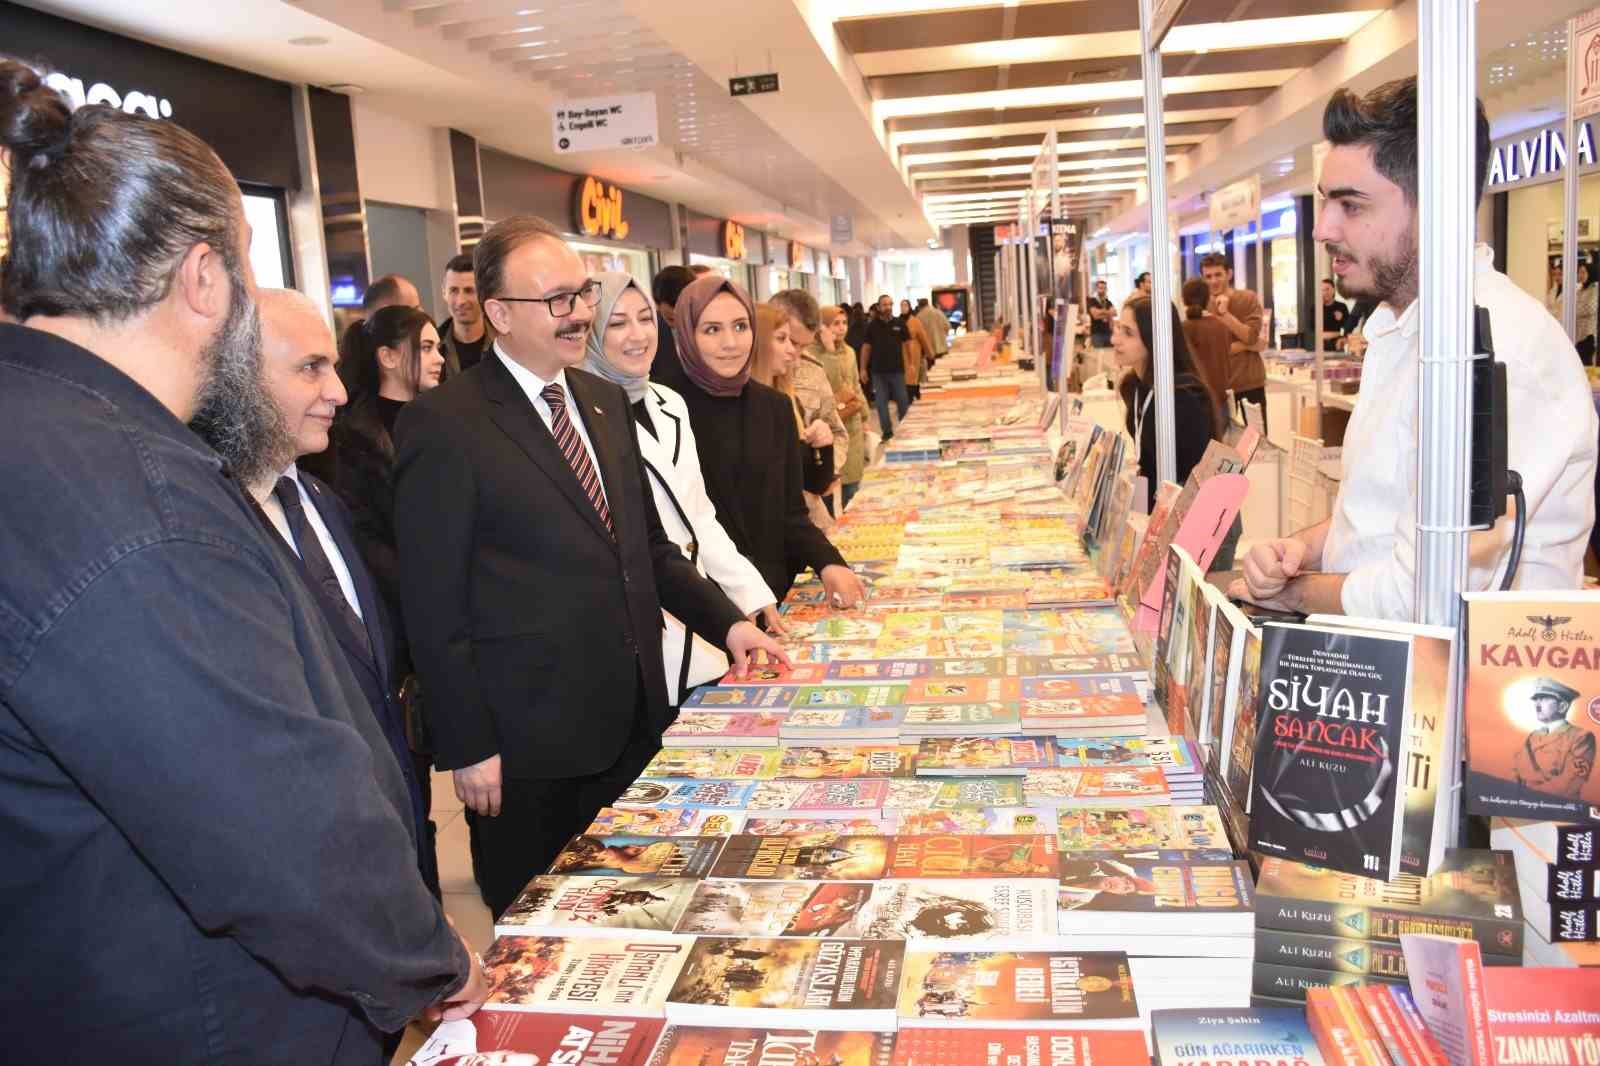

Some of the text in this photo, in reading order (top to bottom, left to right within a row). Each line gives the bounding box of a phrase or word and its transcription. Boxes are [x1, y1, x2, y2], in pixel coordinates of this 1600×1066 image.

[610, 105, 622, 114] WC
[596, 118, 607, 127] WC
[1268, 674, 1389, 726] SİYAH
[1488, 1008, 1551, 1023] Stresinizi
[1174, 1042, 1208, 1057] GÜN
[1495, 1035, 1570, 1066] ZAMANI
